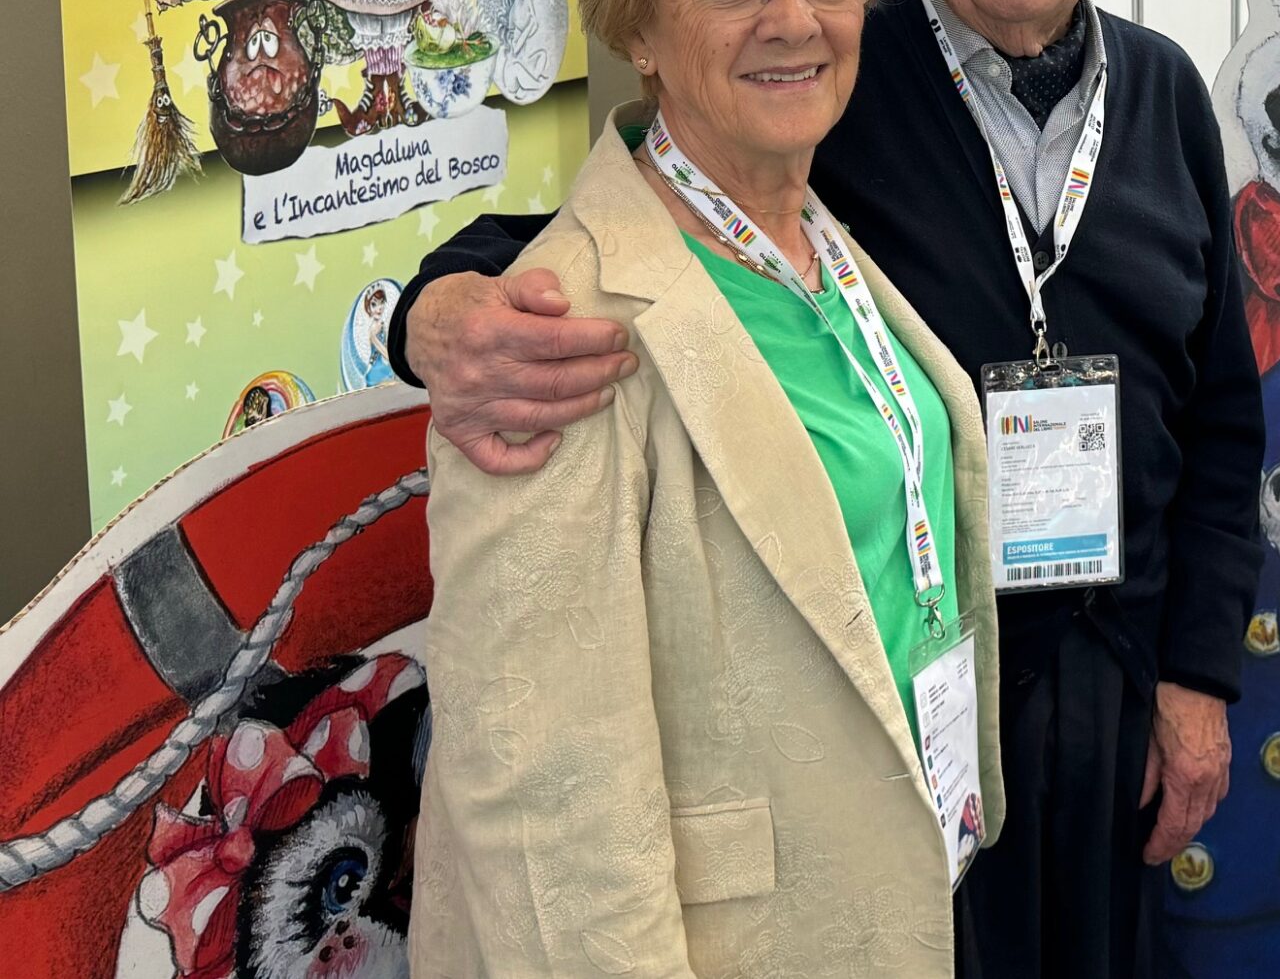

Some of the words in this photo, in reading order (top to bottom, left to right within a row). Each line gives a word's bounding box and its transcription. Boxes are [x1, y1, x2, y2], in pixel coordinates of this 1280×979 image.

[334, 137, 433, 180] Magdaluna
[253, 208, 267, 231] e
[273, 173, 410, 226] l'Incantesimo
[415, 166, 442, 191] del
[448, 153, 501, 179] Bosco
[1007, 542, 1054, 554] ESPOSITORE
